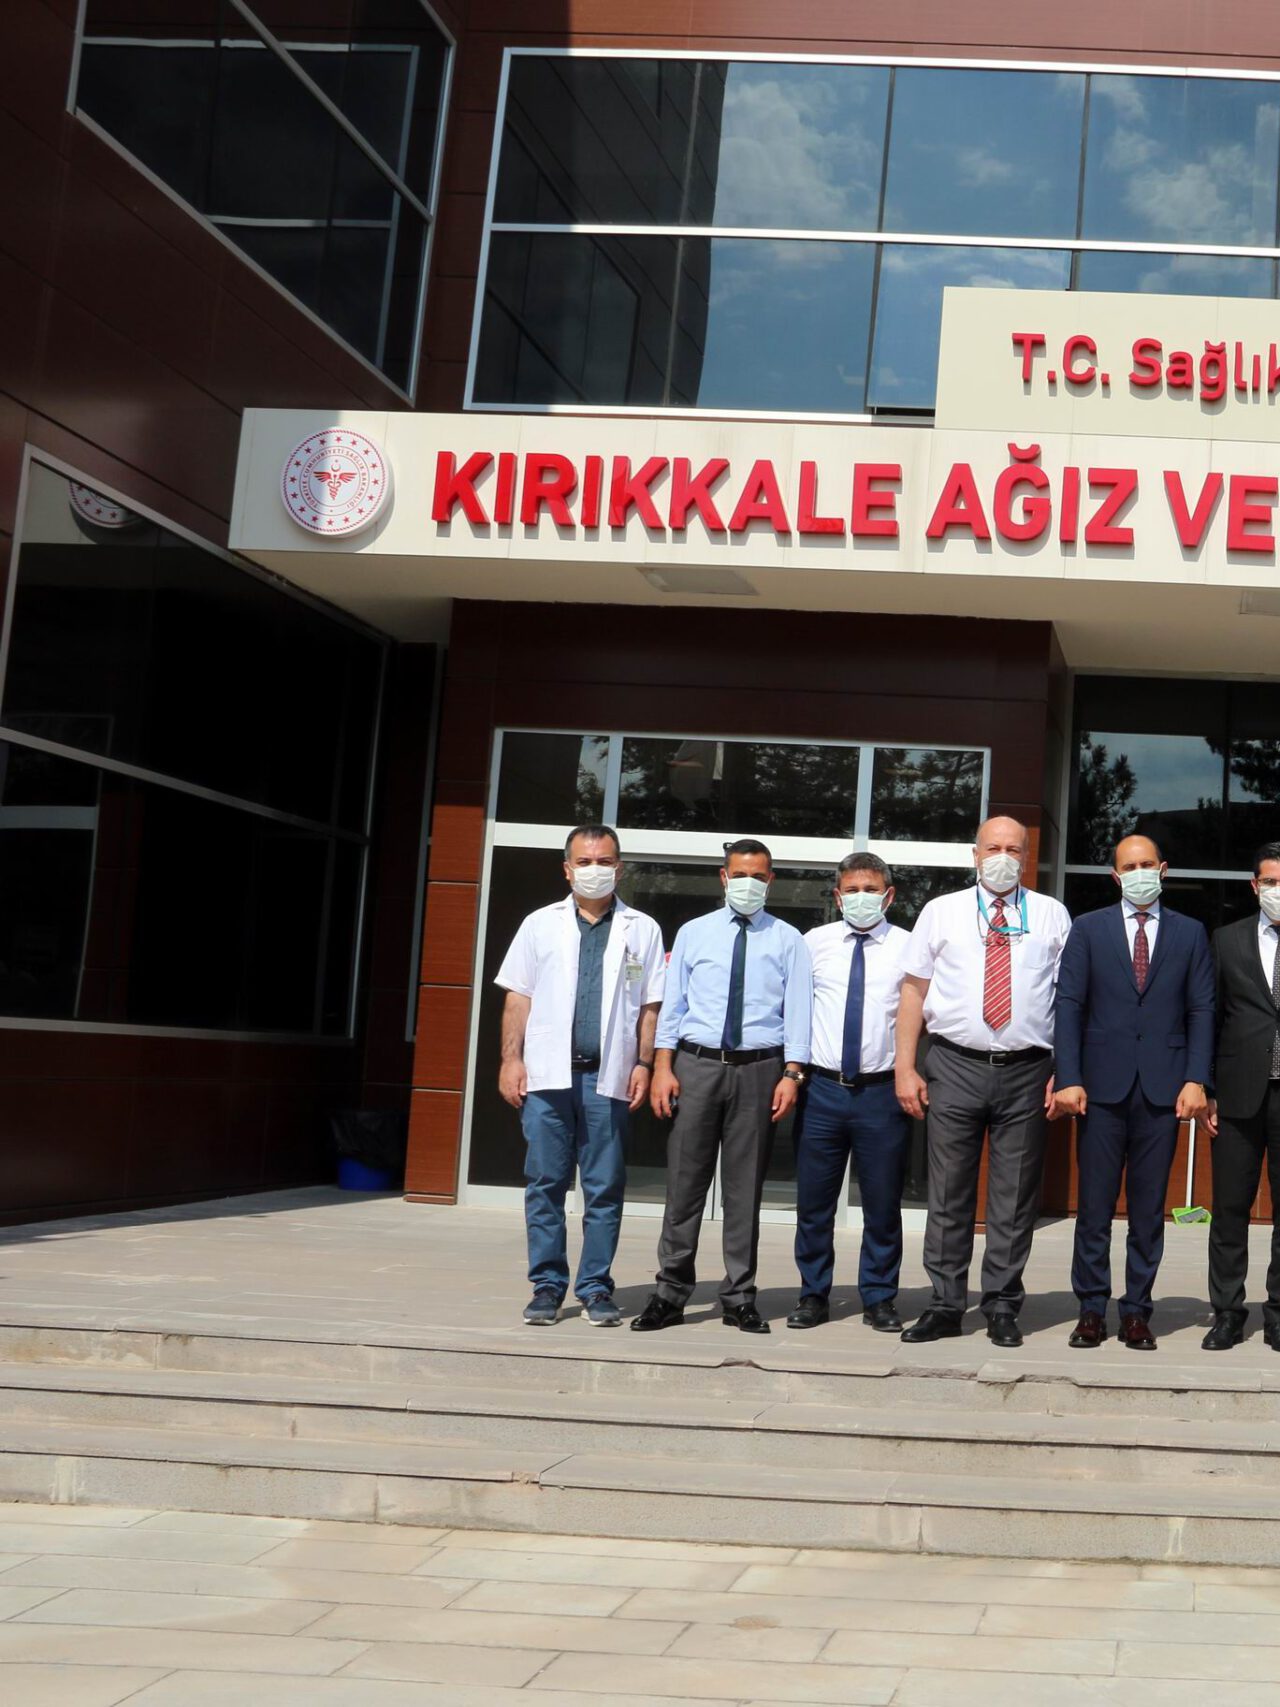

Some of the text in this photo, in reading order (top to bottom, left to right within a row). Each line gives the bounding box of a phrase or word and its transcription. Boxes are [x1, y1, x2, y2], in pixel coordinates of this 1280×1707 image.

[1011, 332, 1111, 387] T.C.
[431, 450, 902, 538] KIRIKKALE
[926, 442, 1139, 546] AĞIZ
[1163, 470, 1279, 554] VE
